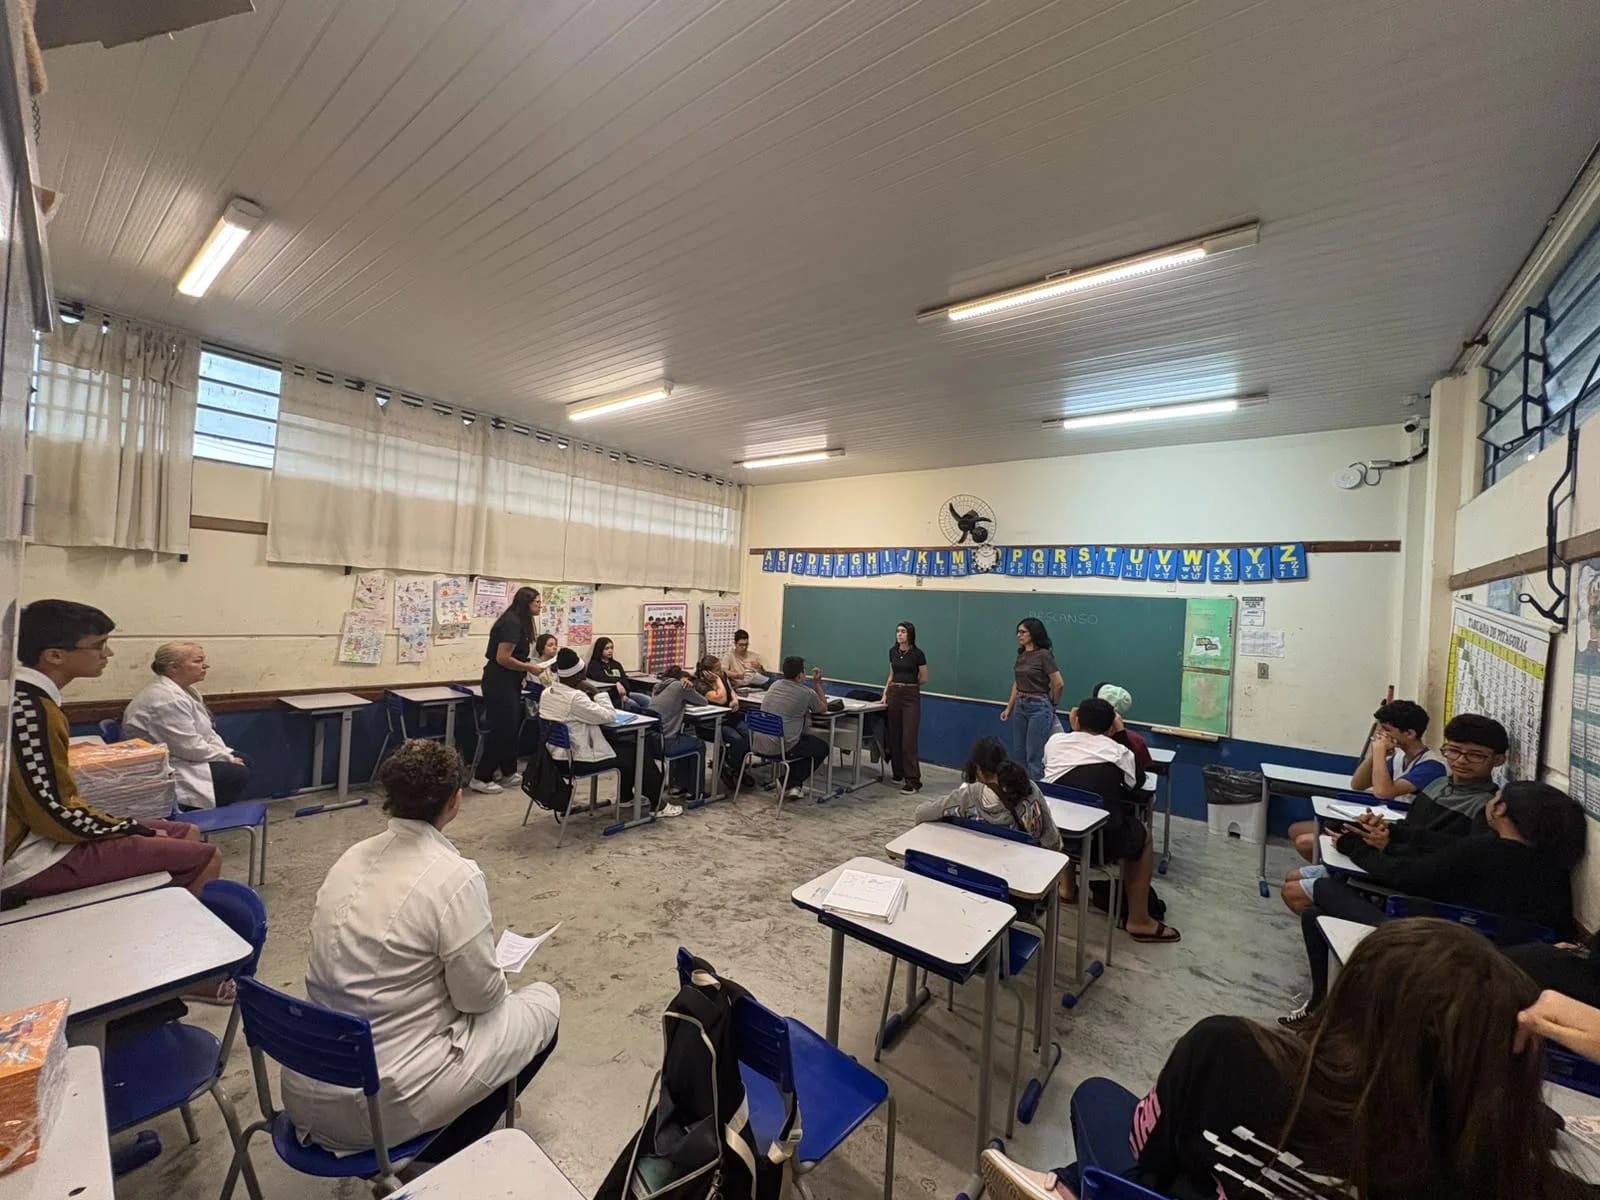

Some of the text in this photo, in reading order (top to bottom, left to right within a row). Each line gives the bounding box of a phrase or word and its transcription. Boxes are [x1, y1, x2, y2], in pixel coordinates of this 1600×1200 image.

[766, 550, 773, 561] A
[779, 550, 786, 561] B
[796, 552, 803, 563] C
[809, 553, 816, 564] D
[823, 554, 830, 565] E
[852, 553, 860, 564] G
[918, 551, 928, 564] K
[936, 551, 944, 564] L
[952, 551, 964, 564] M
[1012, 548, 1023, 563] P
[1032, 548, 1044, 563] Q
[1054, 548, 1067, 563] R
[1078, 547, 1090, 562] S
[1104, 547, 1117, 562] T
[1130, 548, 1144, 564] U
[1157, 549, 1173, 565] V
[1182, 549, 1203, 565] W
[1215, 548, 1232, 565] X
[1246, 547, 1263, 564] Y
[1280, 545, 1297, 562] Z
